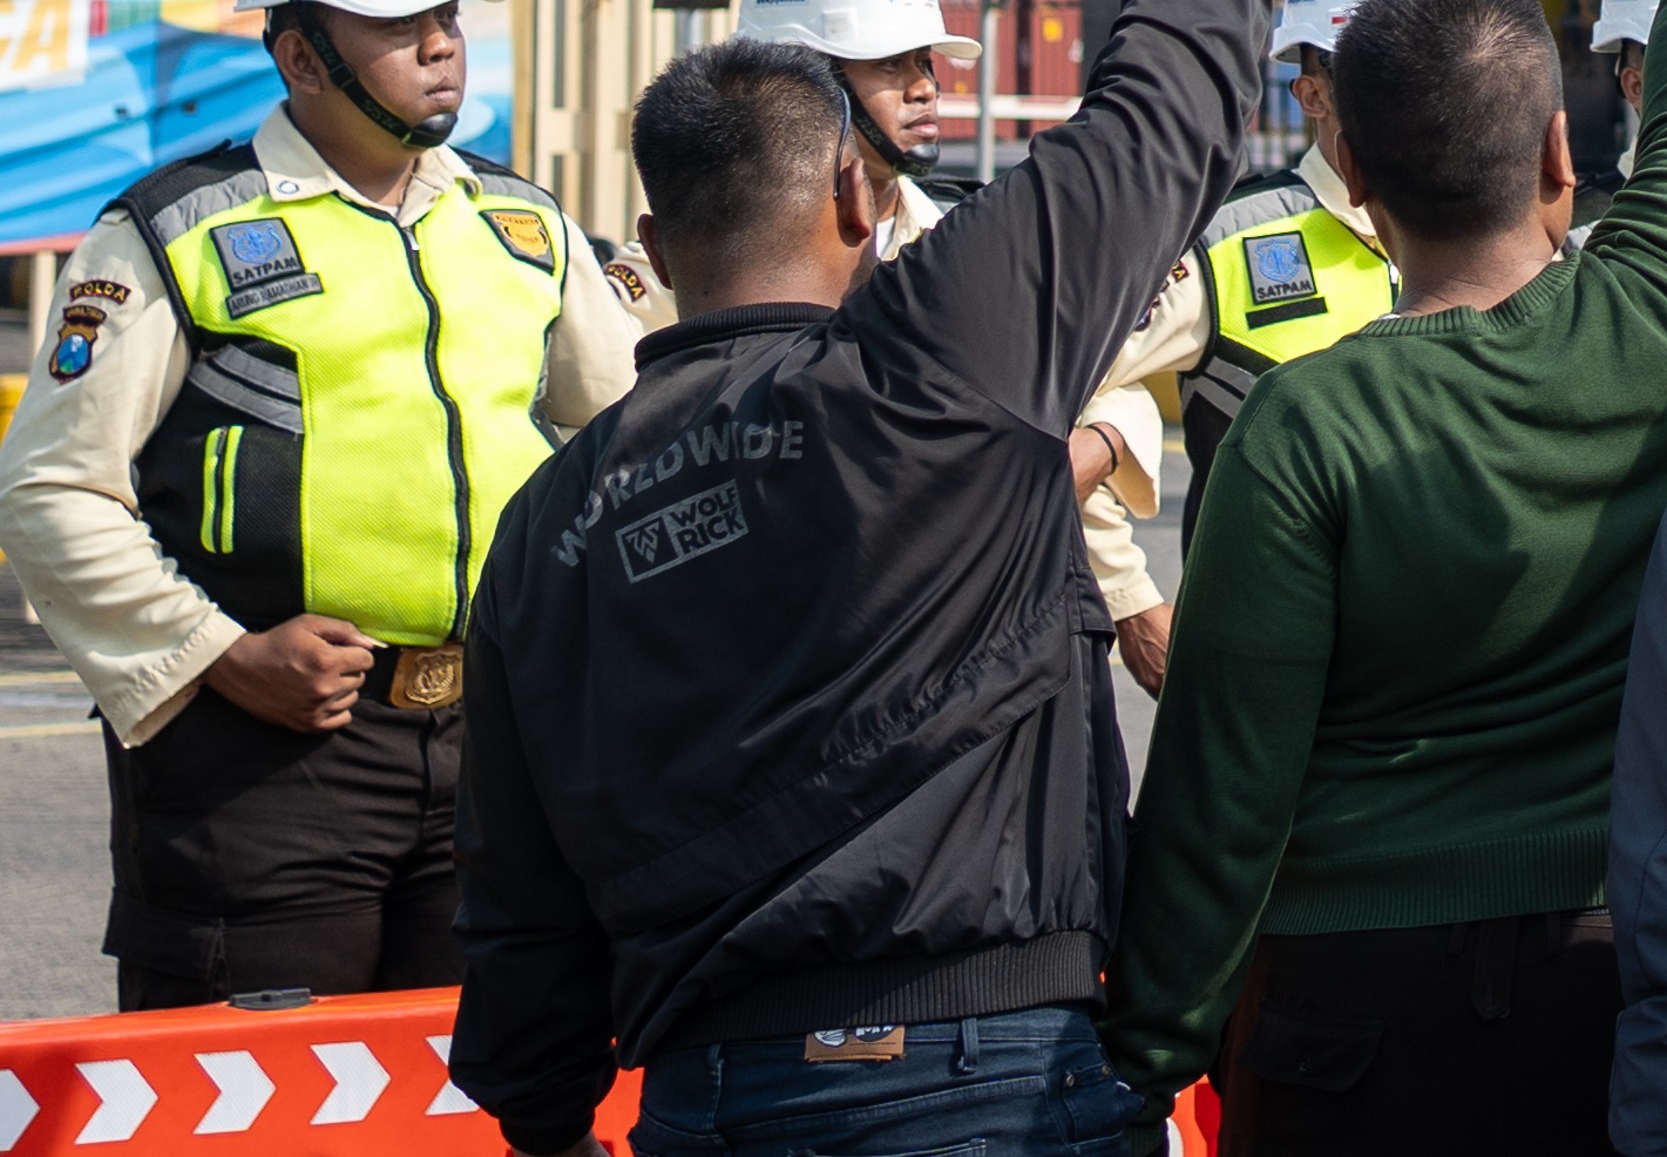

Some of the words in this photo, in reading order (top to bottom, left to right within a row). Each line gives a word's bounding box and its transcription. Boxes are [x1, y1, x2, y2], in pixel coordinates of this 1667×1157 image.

[232, 256, 298, 284] SATPAM
[606, 265, 645, 298] POLDA
[73, 283, 125, 301] POLDA
[1257, 279, 1313, 300] SATPAM
[551, 420, 804, 568] WORLDWIDE
[670, 484, 739, 526] WOLF
[676, 509, 745, 554] RICK
